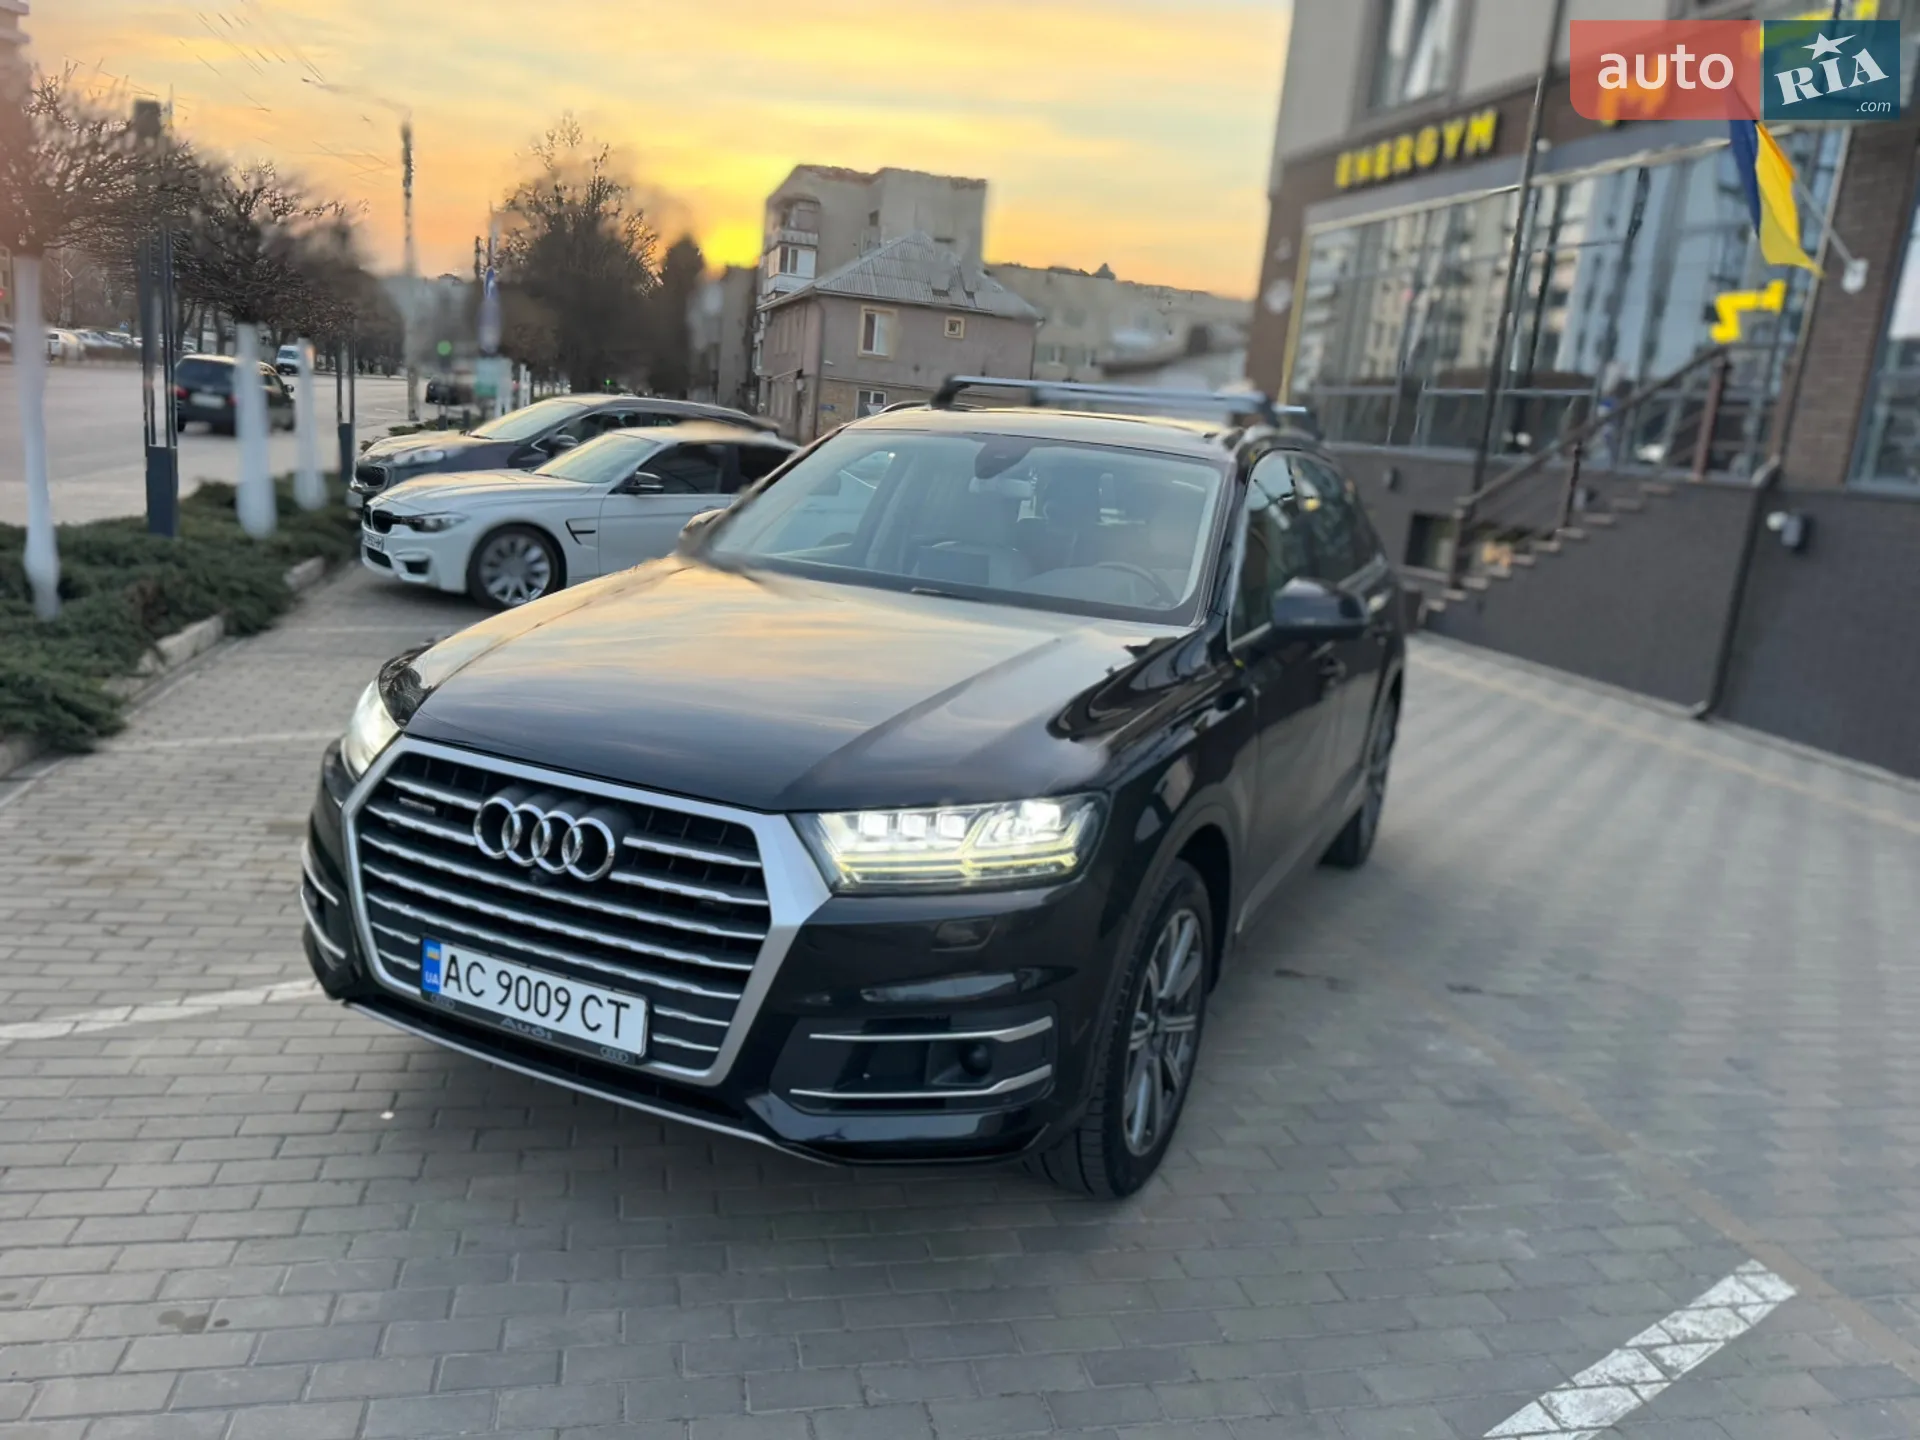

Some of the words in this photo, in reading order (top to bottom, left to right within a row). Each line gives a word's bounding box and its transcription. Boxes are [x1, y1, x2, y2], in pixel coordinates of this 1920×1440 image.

[1334, 107, 1498, 189] ENERGYM
[424, 971, 440, 985] UA
[443, 954, 487, 997] AC
[496, 970, 571, 1022] 9009
[580, 994, 631, 1039] CT
